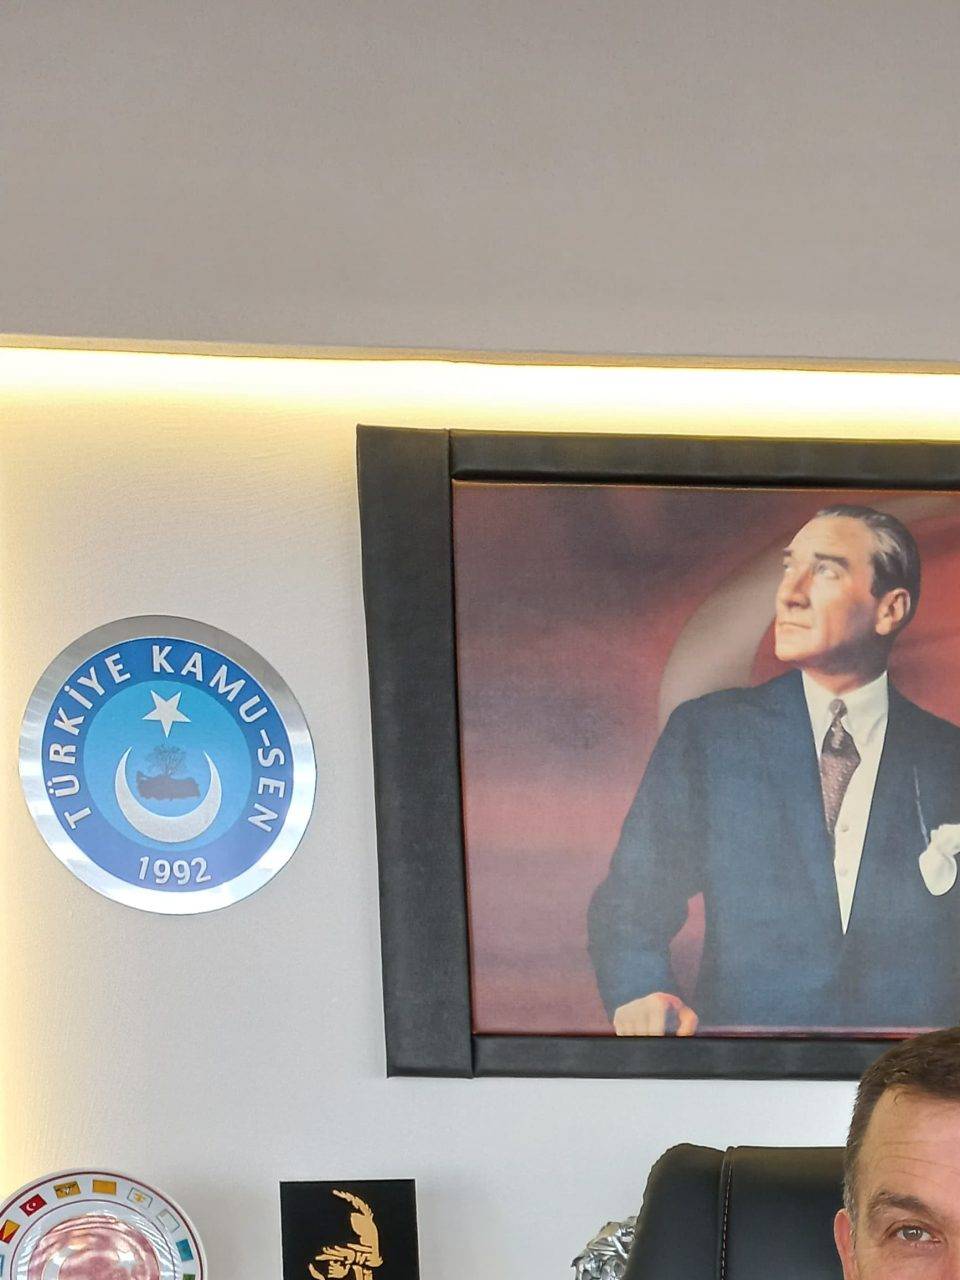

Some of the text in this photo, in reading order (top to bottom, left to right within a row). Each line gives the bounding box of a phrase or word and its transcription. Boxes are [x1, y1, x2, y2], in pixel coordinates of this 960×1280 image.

[48, 645, 287, 833] TÜRKİYE KAMU-SEN
[138, 856, 213, 886] 1992
